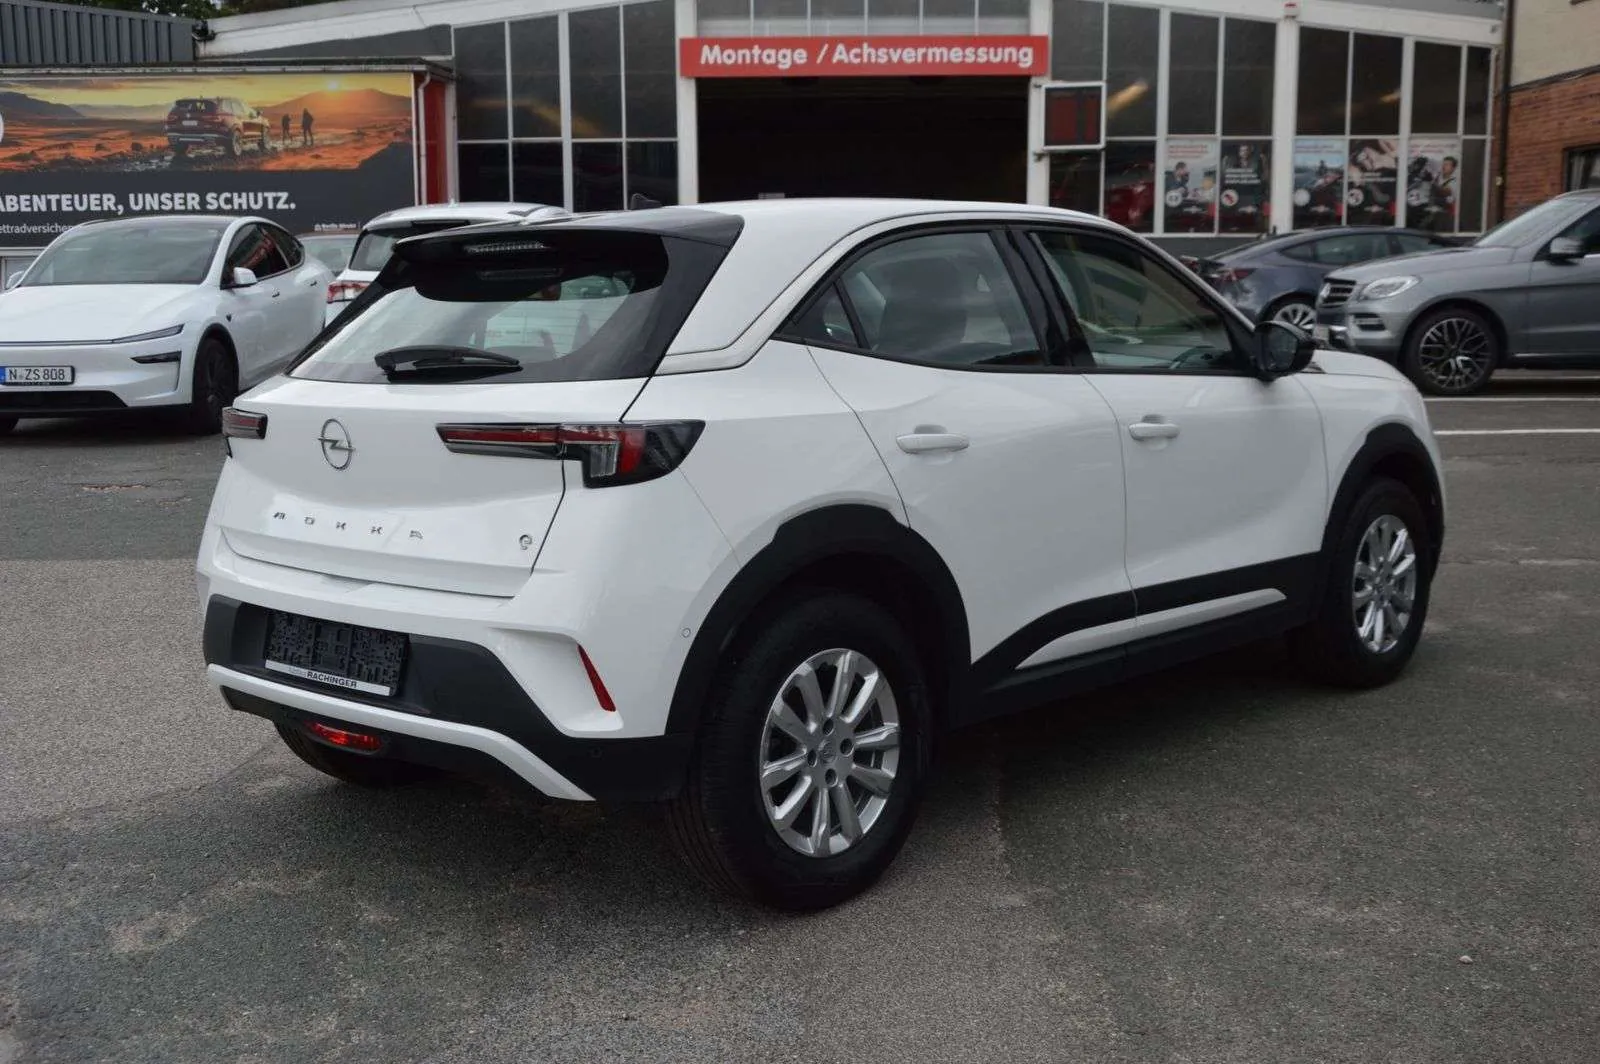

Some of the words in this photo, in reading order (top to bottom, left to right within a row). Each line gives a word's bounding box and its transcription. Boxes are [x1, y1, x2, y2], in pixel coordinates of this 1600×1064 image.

[700, 44, 807, 70] Montage
[832, 41, 1034, 69] Achsvermessung
[129, 192, 200, 212] UNSER
[205, 191, 296, 210] SCHUTZ.
[9, 369, 18, 380] N
[24, 369, 40, 380] ZS
[306, 671, 357, 689] RACHINGER
